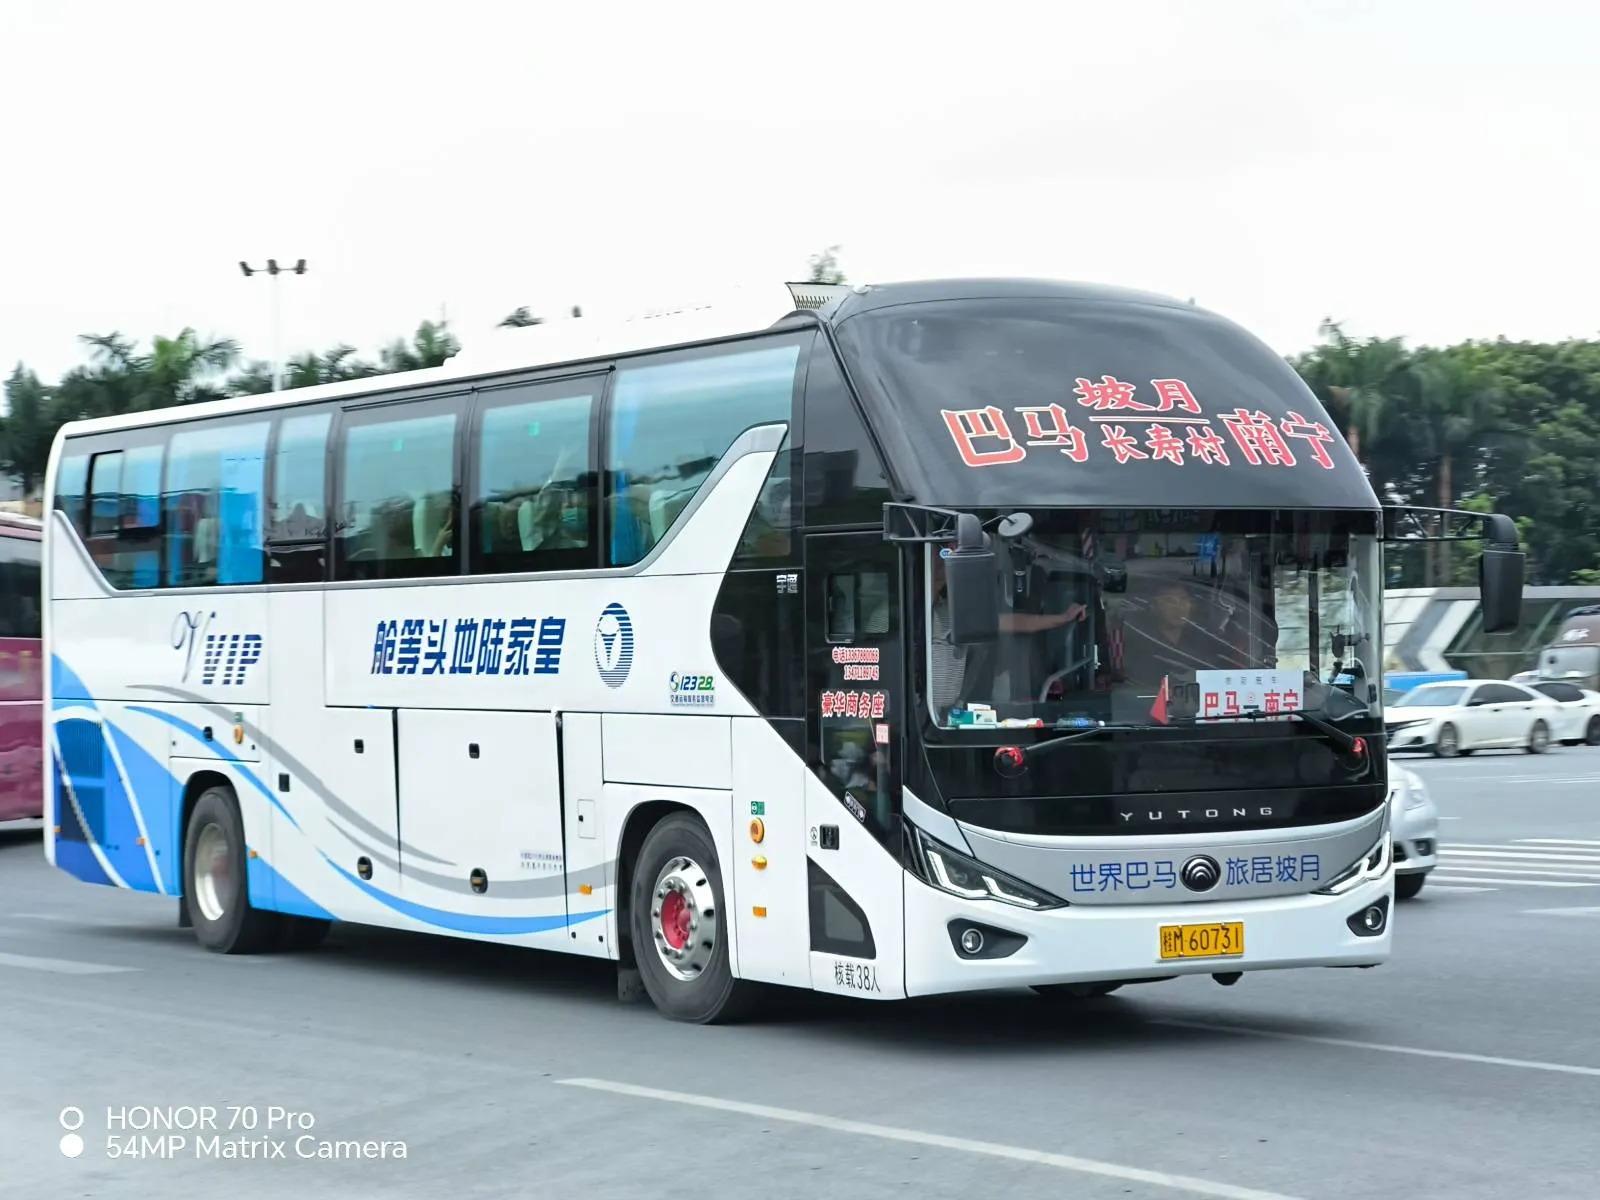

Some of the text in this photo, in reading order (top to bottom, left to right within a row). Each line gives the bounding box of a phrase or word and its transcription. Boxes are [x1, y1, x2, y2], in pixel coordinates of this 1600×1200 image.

[1073, 376, 1202, 414] 坡月
[941, 404, 1089, 467] 巴马
[1101, 423, 1230, 466] 长寿村
[1217, 408, 1335, 470] 南宁
[821, 690, 885, 719] 豪华商务座
[1120, 807, 1273, 822] YUTONG
[1070, 854, 1320, 893] 世界巴马 旅居坡月
[834, 960, 881, 992] 核载38人
